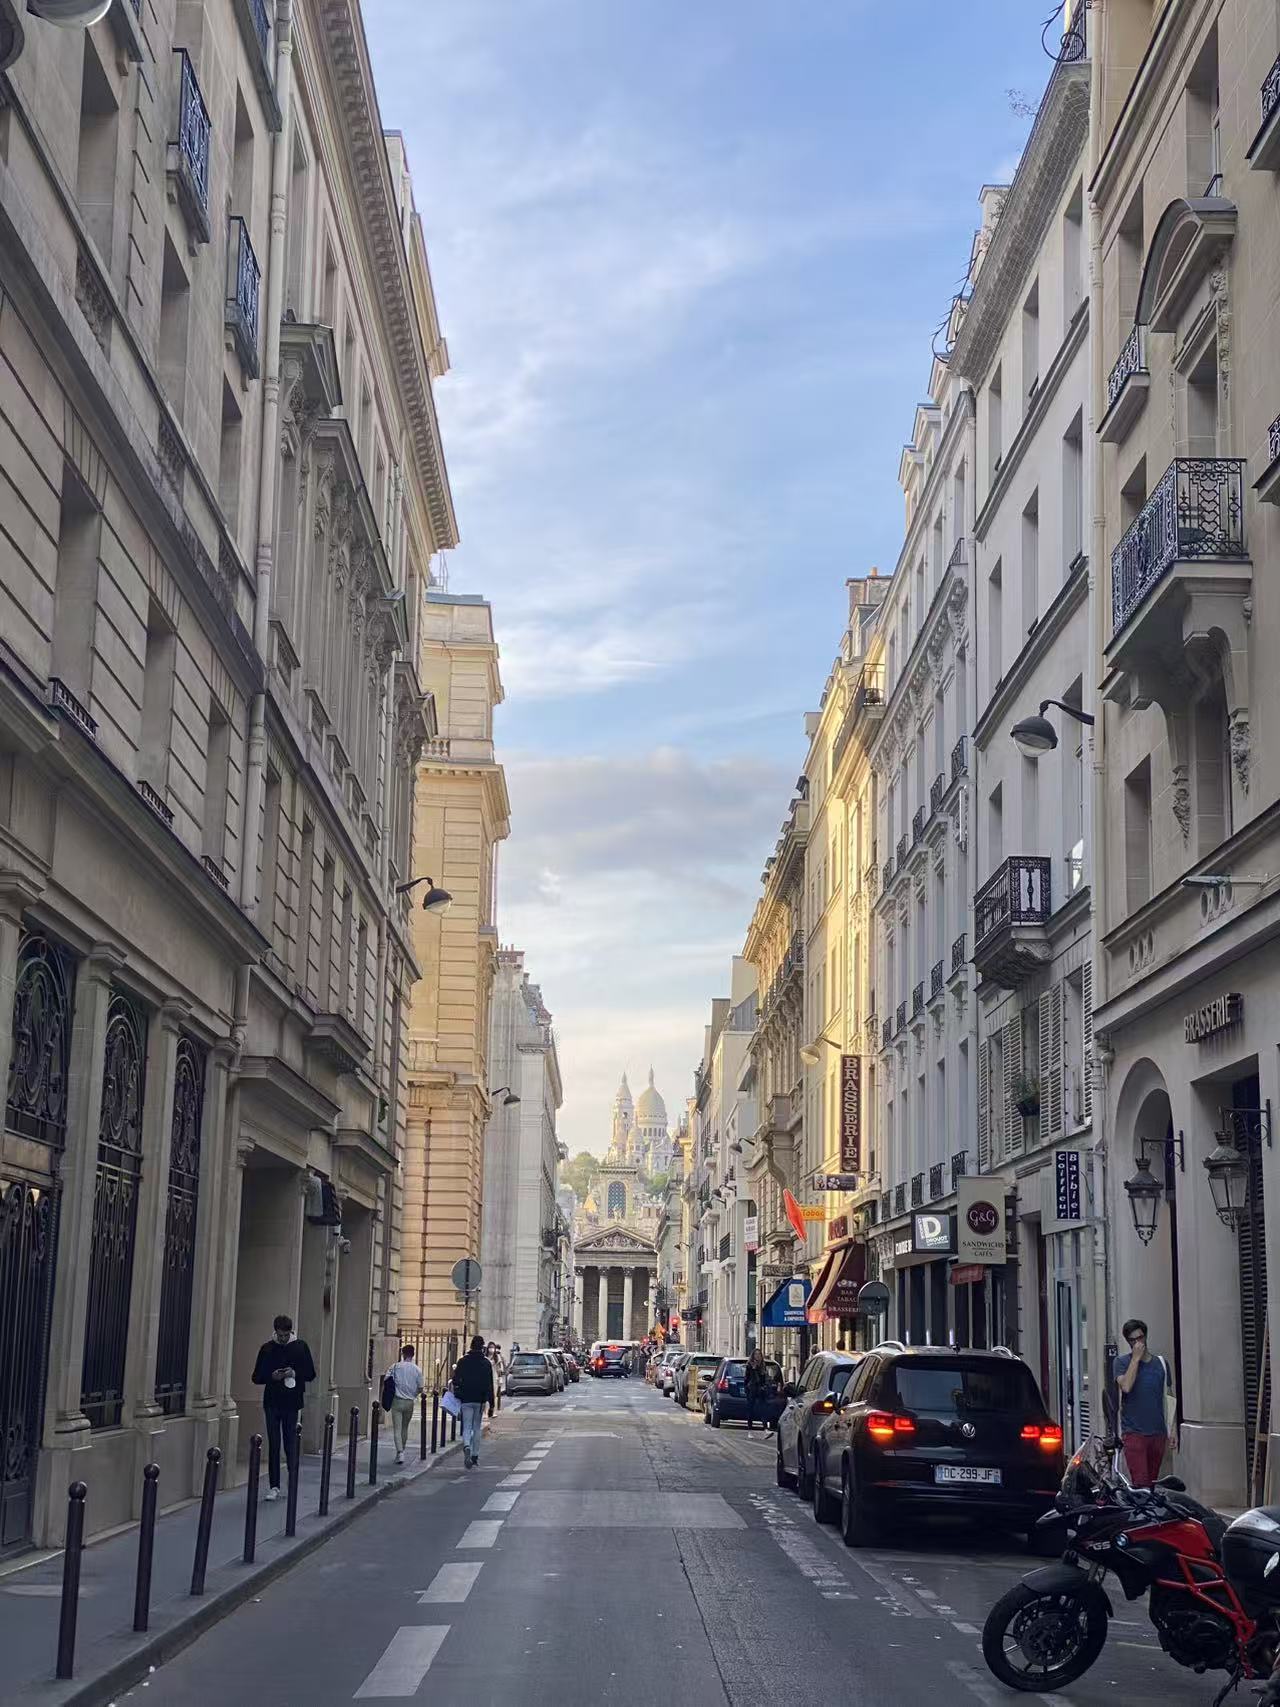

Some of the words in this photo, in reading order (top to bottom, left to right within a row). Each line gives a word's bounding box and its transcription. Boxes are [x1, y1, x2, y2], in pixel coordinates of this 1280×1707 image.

[1184, 993, 1231, 1042] BRASSERIE
[844, 1057, 858, 1159] BRASSERIE
[1057, 1153, 1067, 1218] Coiffeur
[1069, 1153, 1078, 1218] Barbier
[969, 1209, 995, 1227] G&G
[962, 1240, 1005, 1248] SANDWICHS
[943, 1467, 993, 1480] DC-299-JF
